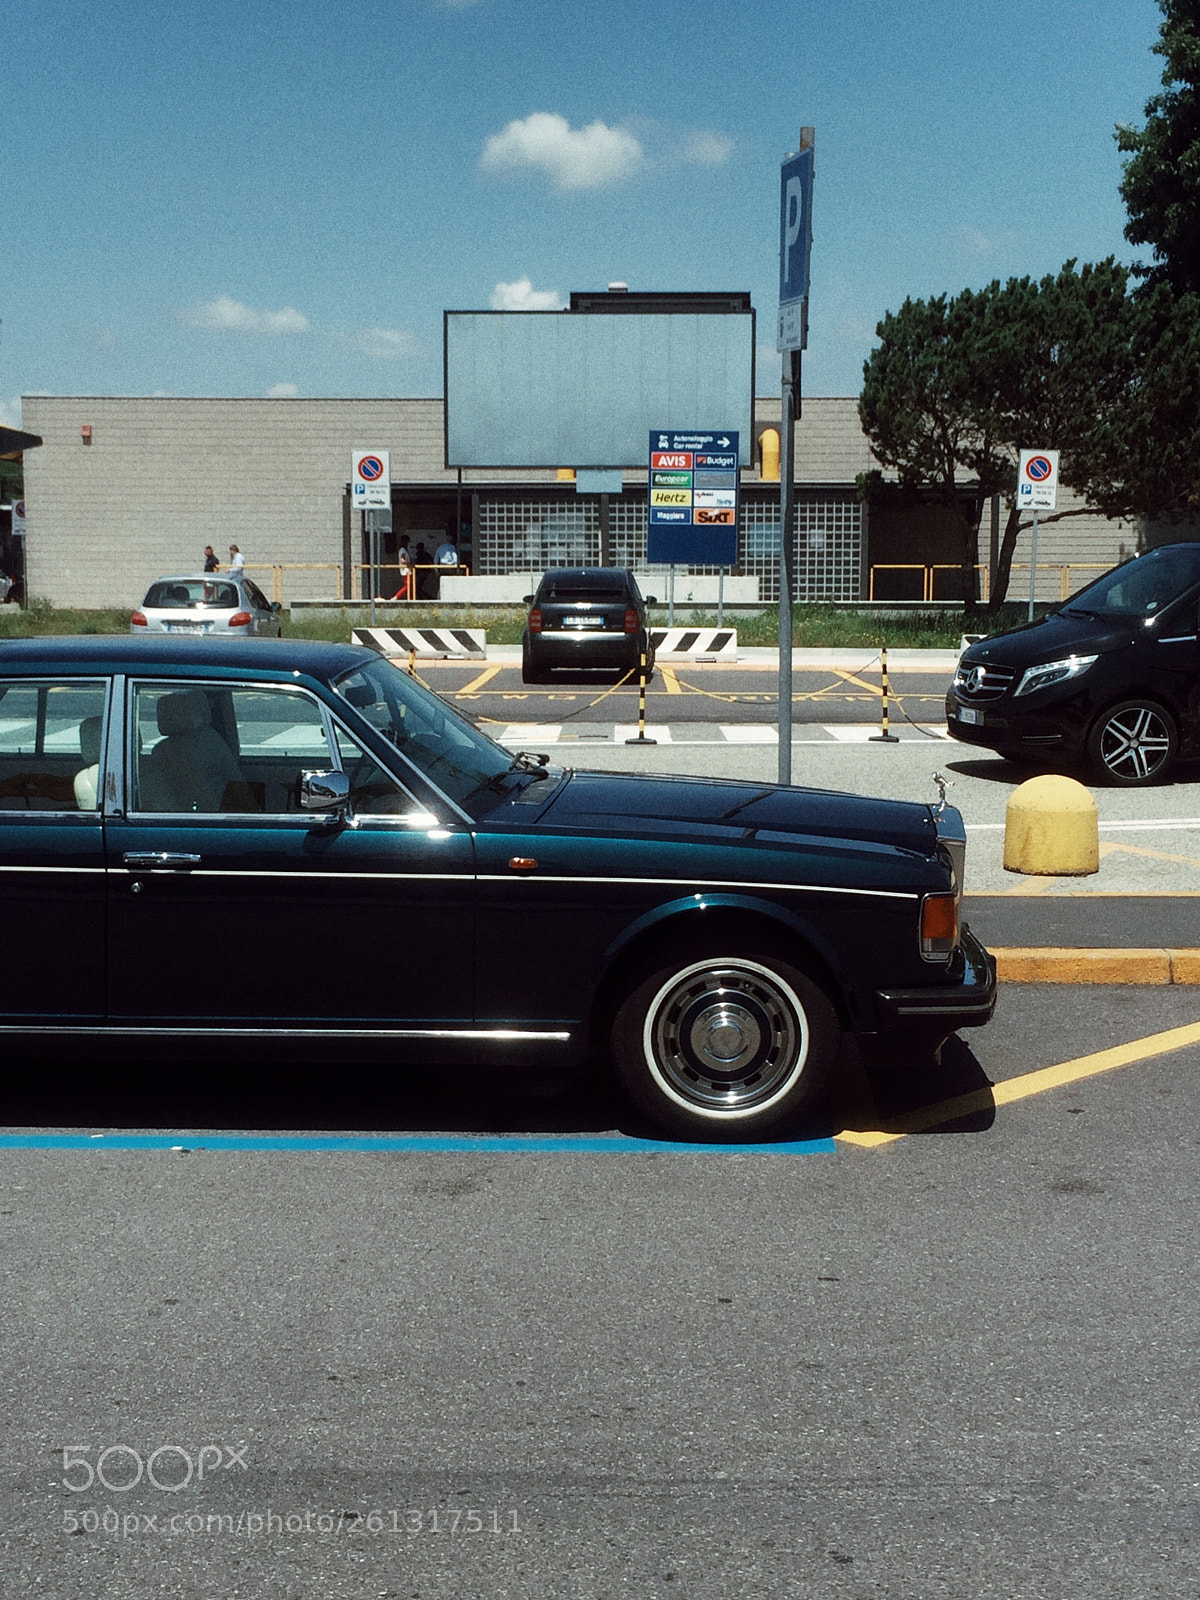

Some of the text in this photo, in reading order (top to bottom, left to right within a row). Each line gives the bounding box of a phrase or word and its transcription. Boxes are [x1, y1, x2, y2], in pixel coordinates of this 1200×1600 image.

[784, 175, 802, 283] P
[658, 455, 686, 467] AVIS
[706, 456, 734, 467] Budget
[654, 474, 689, 485] Europcar
[655, 492, 687, 503] Hertz
